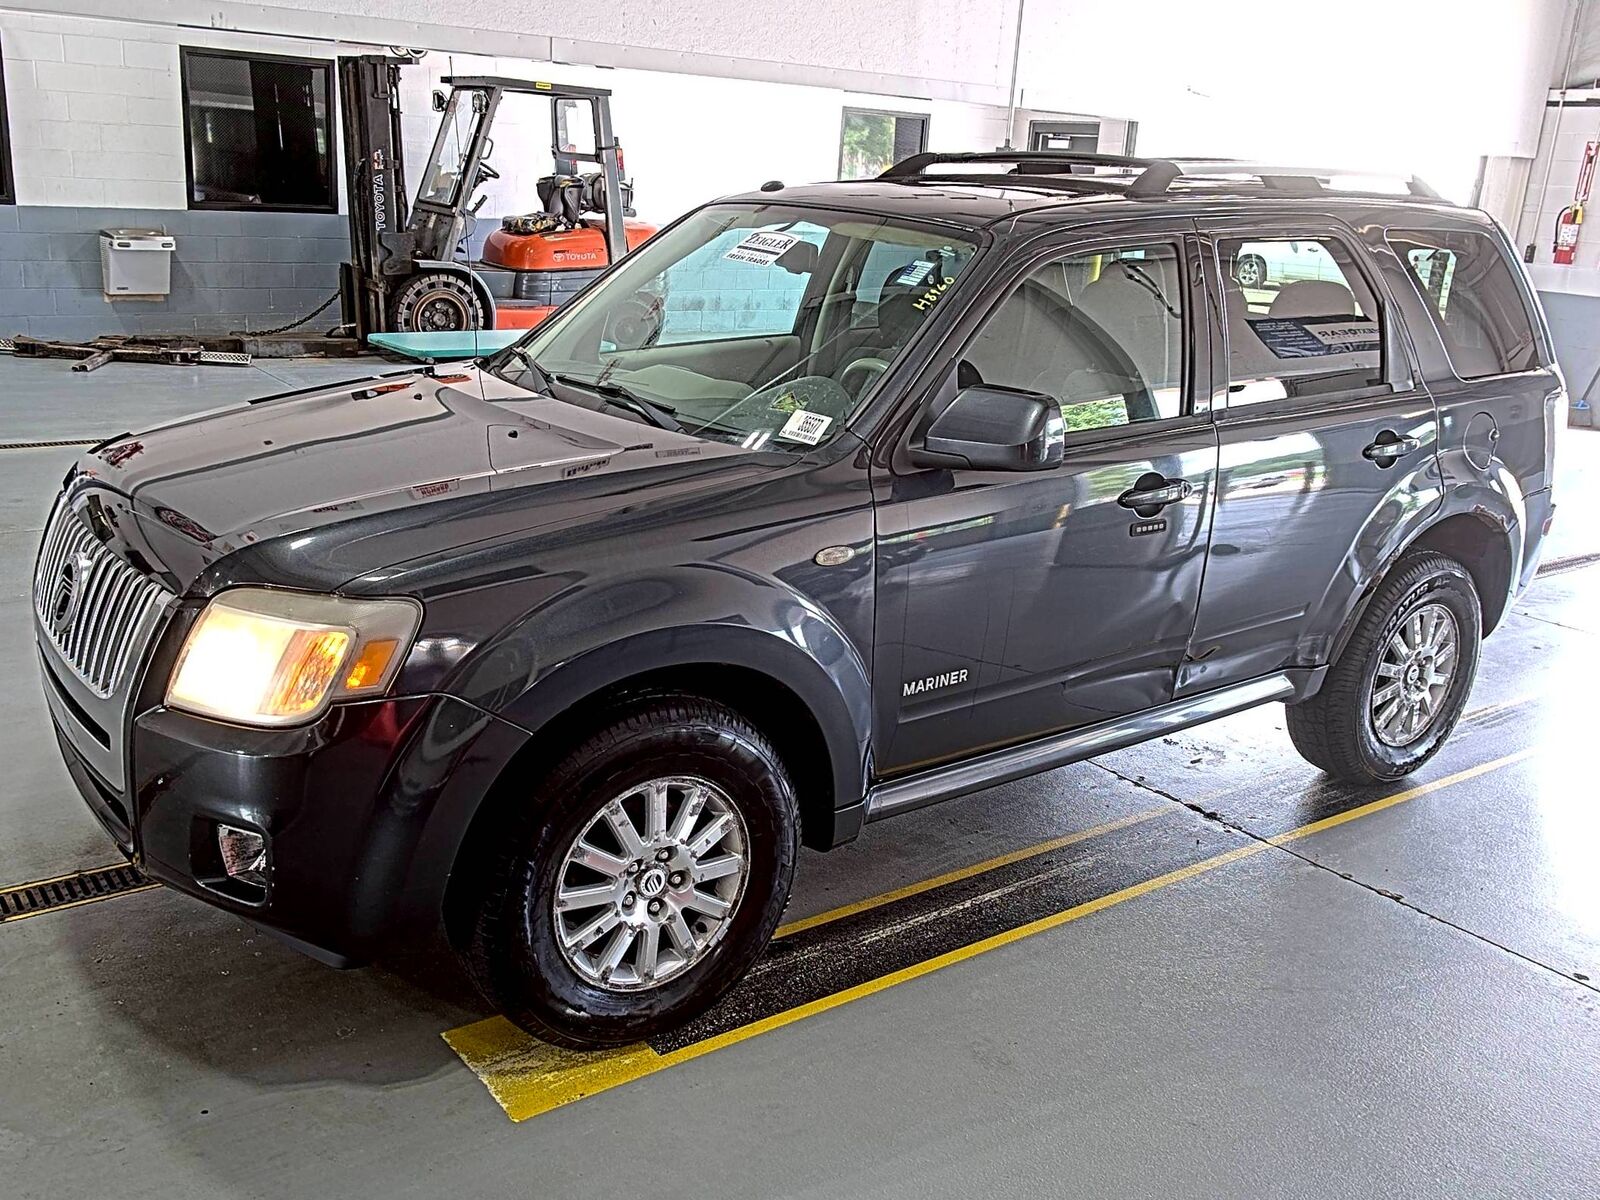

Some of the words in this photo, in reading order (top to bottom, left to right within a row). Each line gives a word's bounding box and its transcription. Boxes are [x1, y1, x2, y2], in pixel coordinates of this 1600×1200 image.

[373, 173, 386, 231] TOYOTA
[745, 232, 794, 250] ZEIGLER
[566, 252, 597, 261] TOYOTA
[903, 669, 968, 697] MARINER
